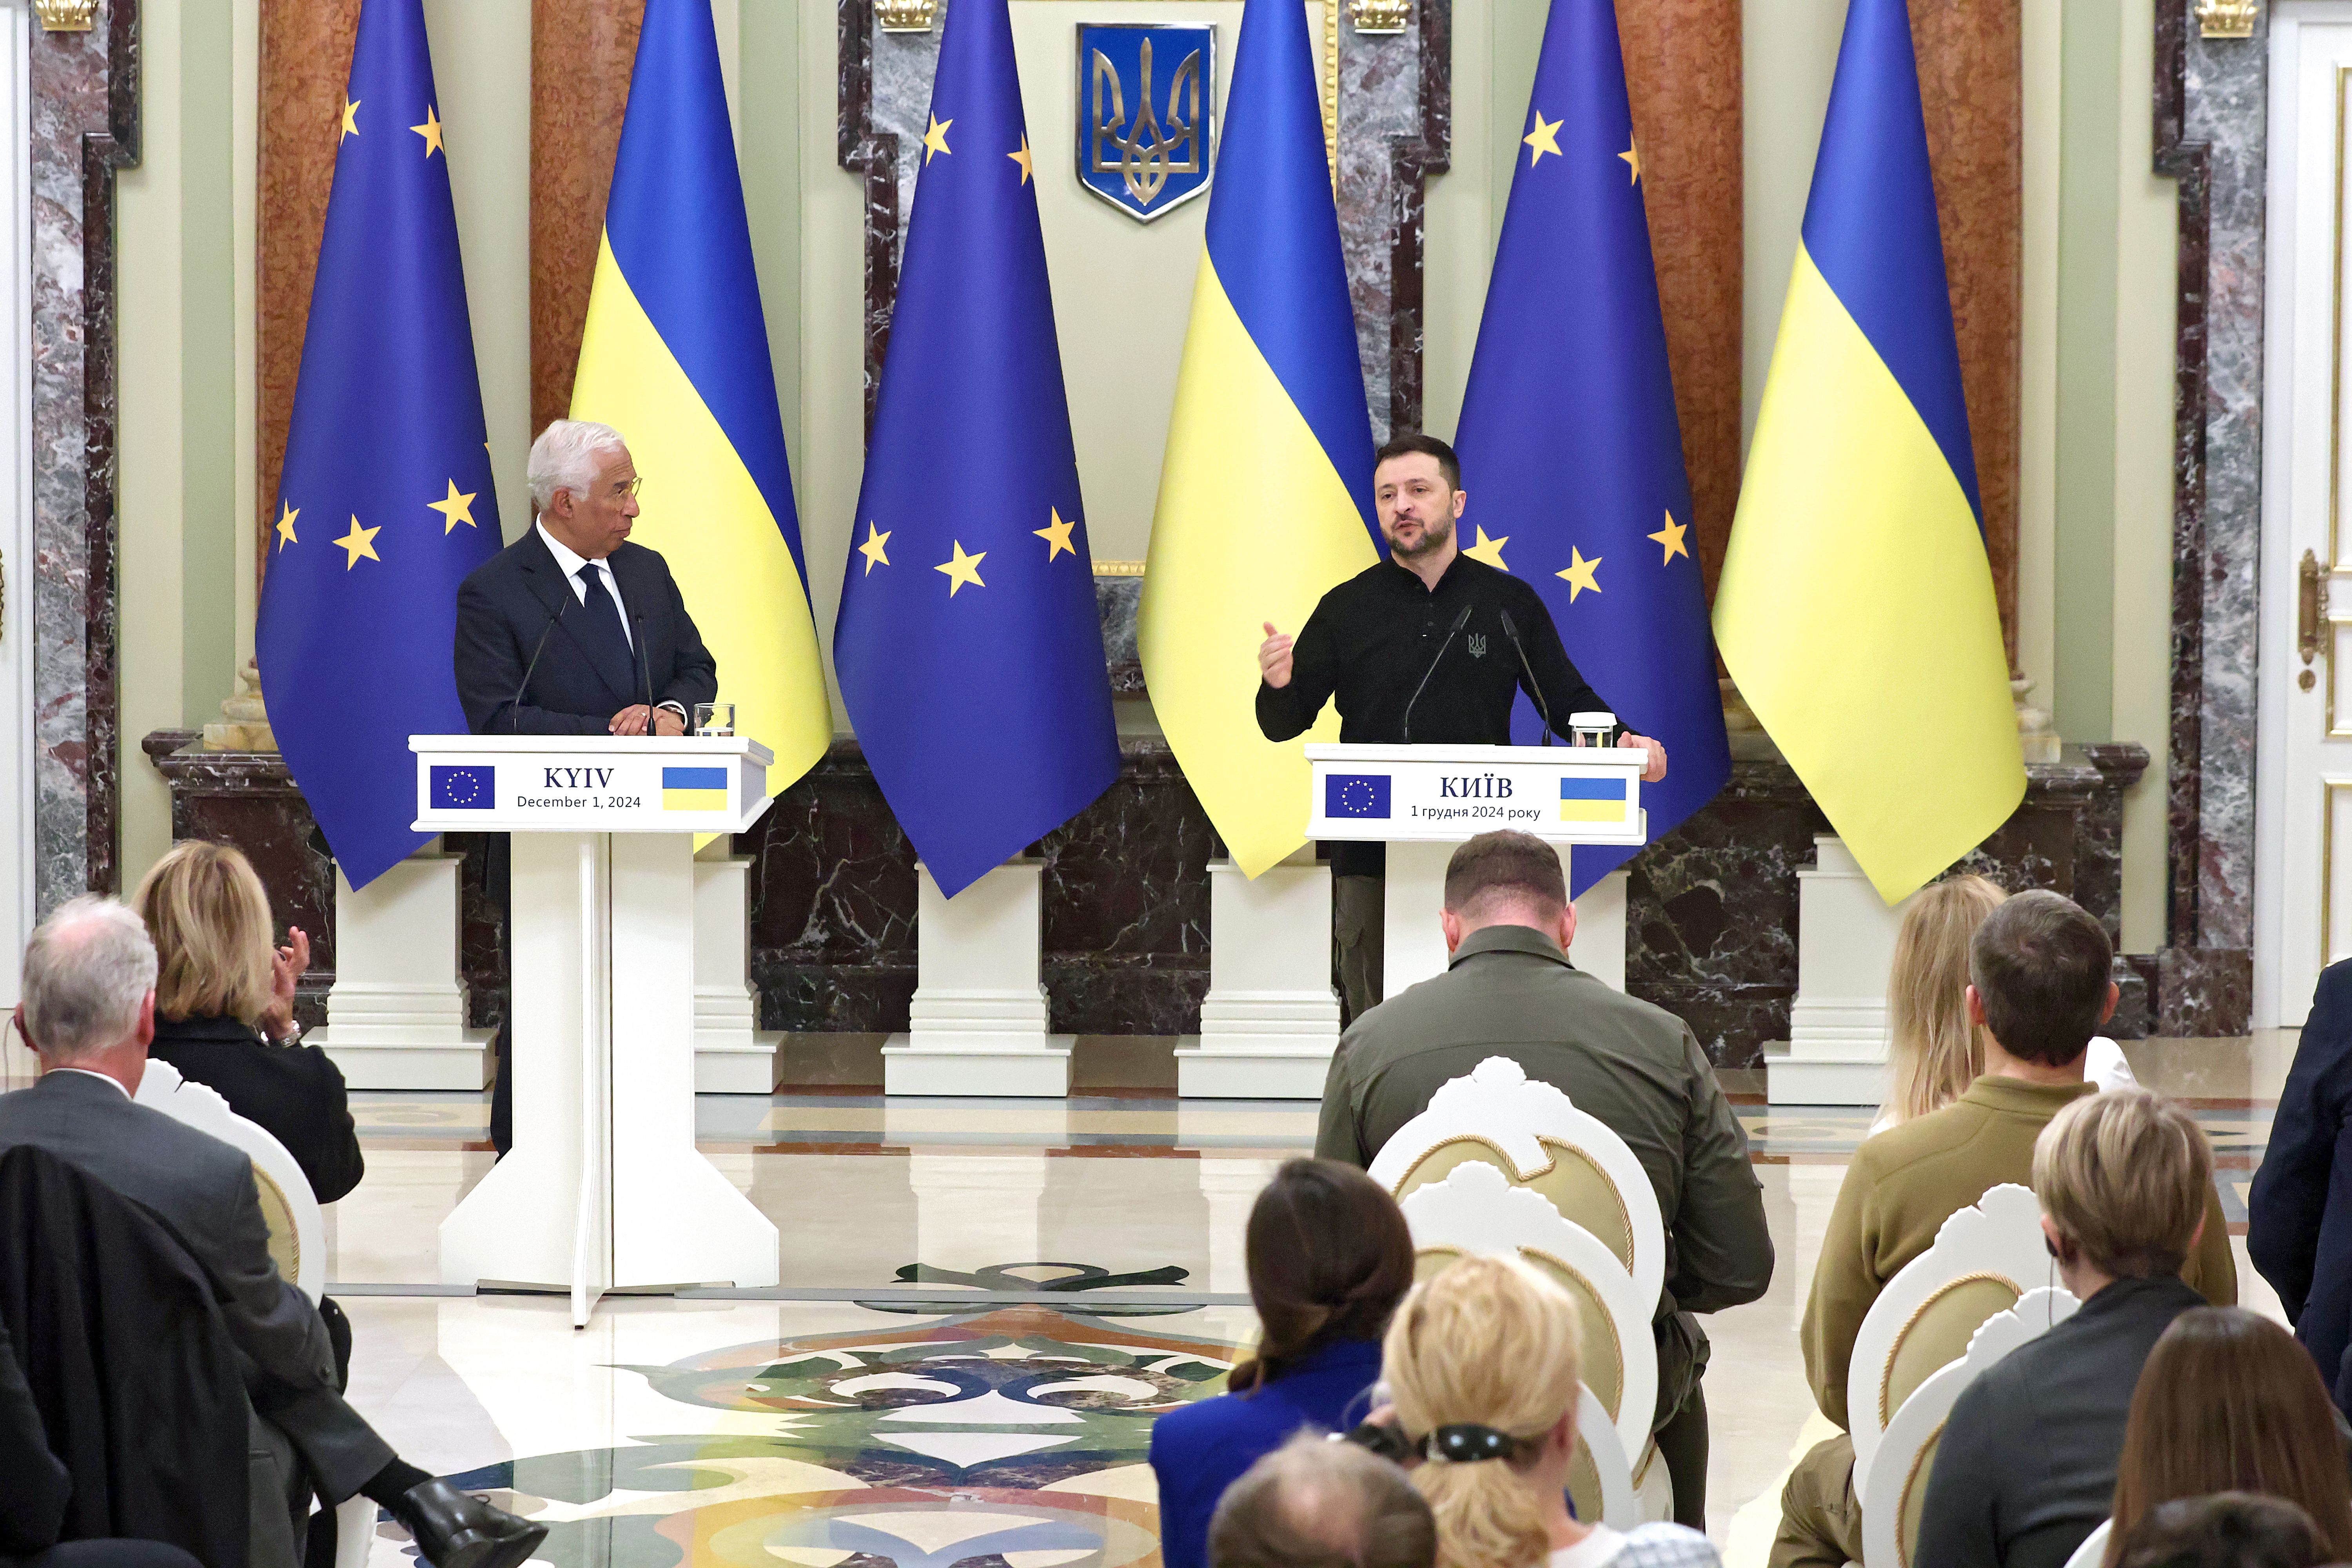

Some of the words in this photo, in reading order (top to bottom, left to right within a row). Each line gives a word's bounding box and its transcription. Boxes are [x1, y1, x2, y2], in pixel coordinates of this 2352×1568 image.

[544, 768, 614, 788] KYIV
[1440, 773, 1512, 798] КИЇВ
[518, 796, 587, 807] December
[593, 797, 603, 809] 1,
[608, 797, 641, 808] 2024
[1412, 806, 1418, 816] 1
[1423, 808, 1468, 820] грудня
[1472, 806, 1504, 817] 2024
[1508, 809, 1541, 821] року
